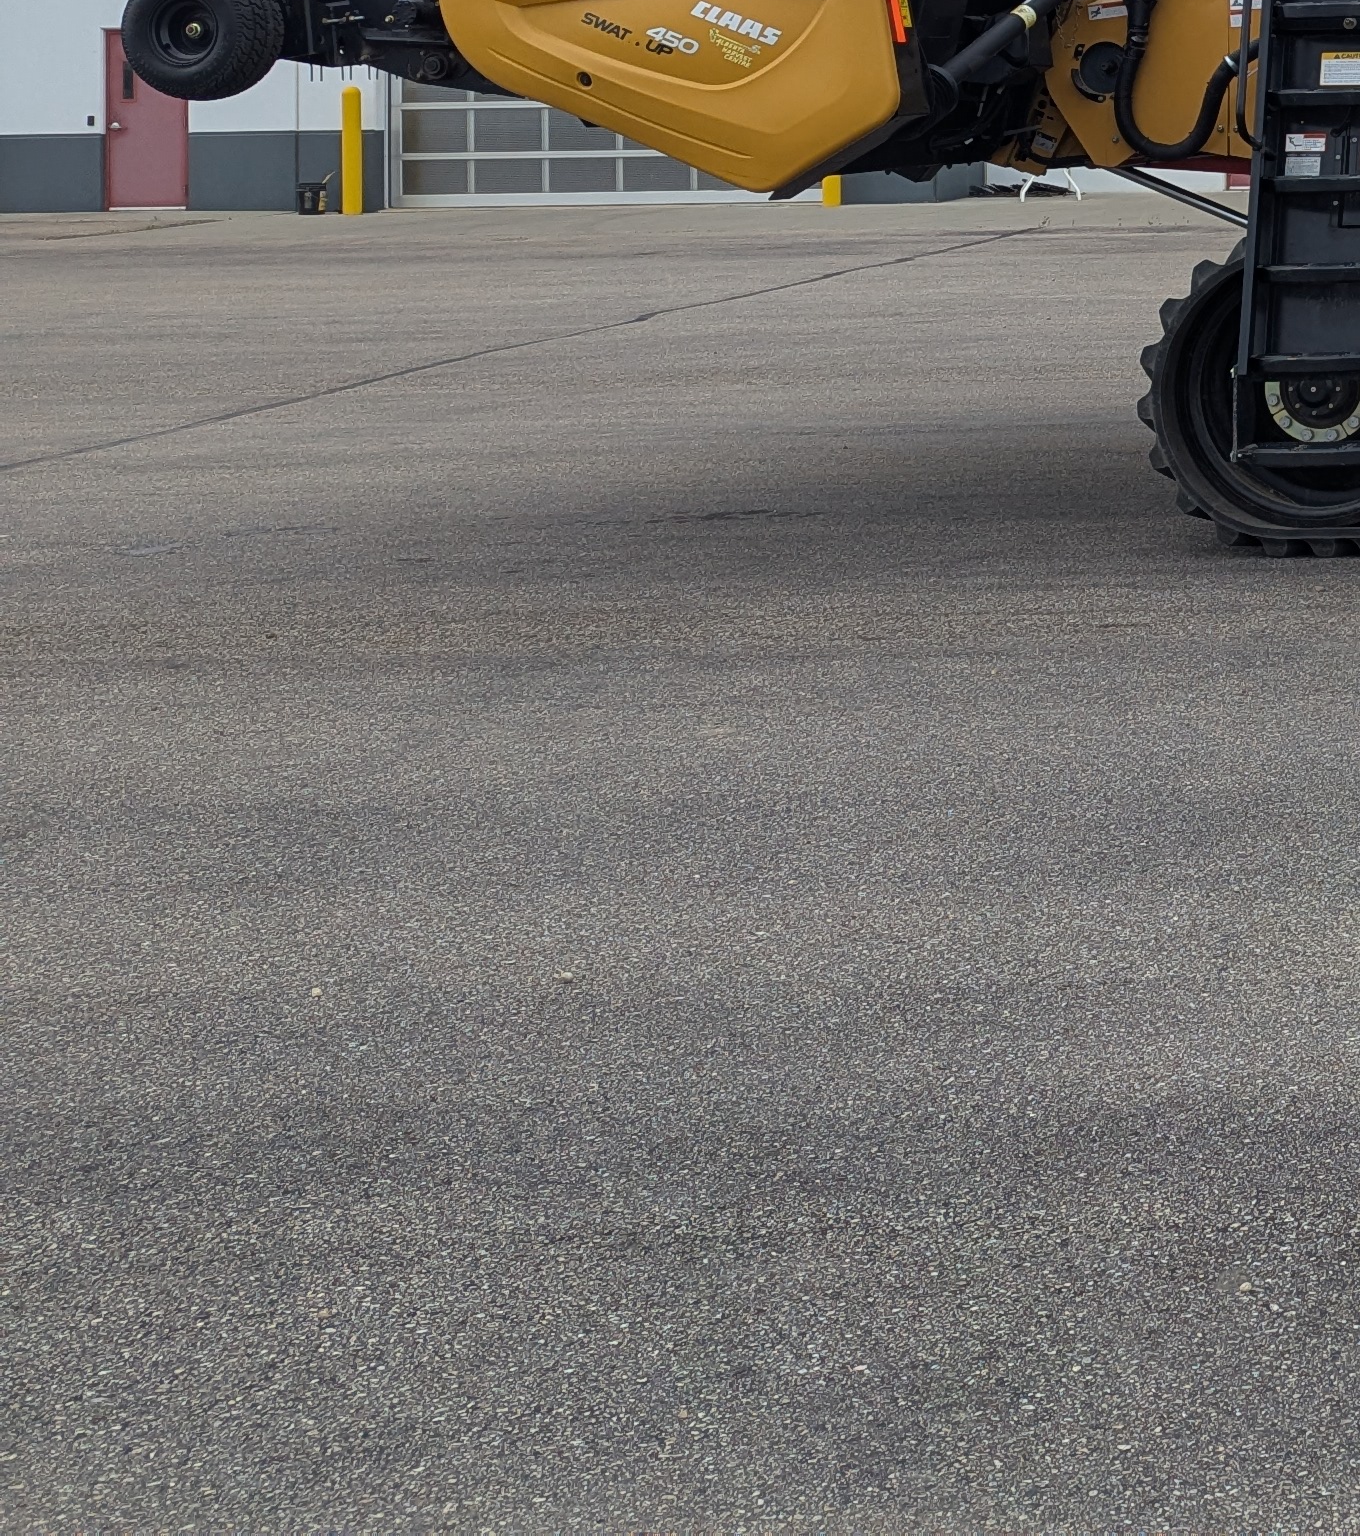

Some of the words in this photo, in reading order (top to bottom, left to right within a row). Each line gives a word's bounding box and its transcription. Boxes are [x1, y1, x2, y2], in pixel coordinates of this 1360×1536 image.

[580, 11, 633, 41] SWAT
[645, 40, 675, 56] UP
[690, 0, 783, 46] CLAAS
[645, 26, 700, 55] 450
[715, 36, 747, 55] ALBERTA
[721, 46, 754, 63] HARVEST
[723, 54, 752, 69] CENTRE
